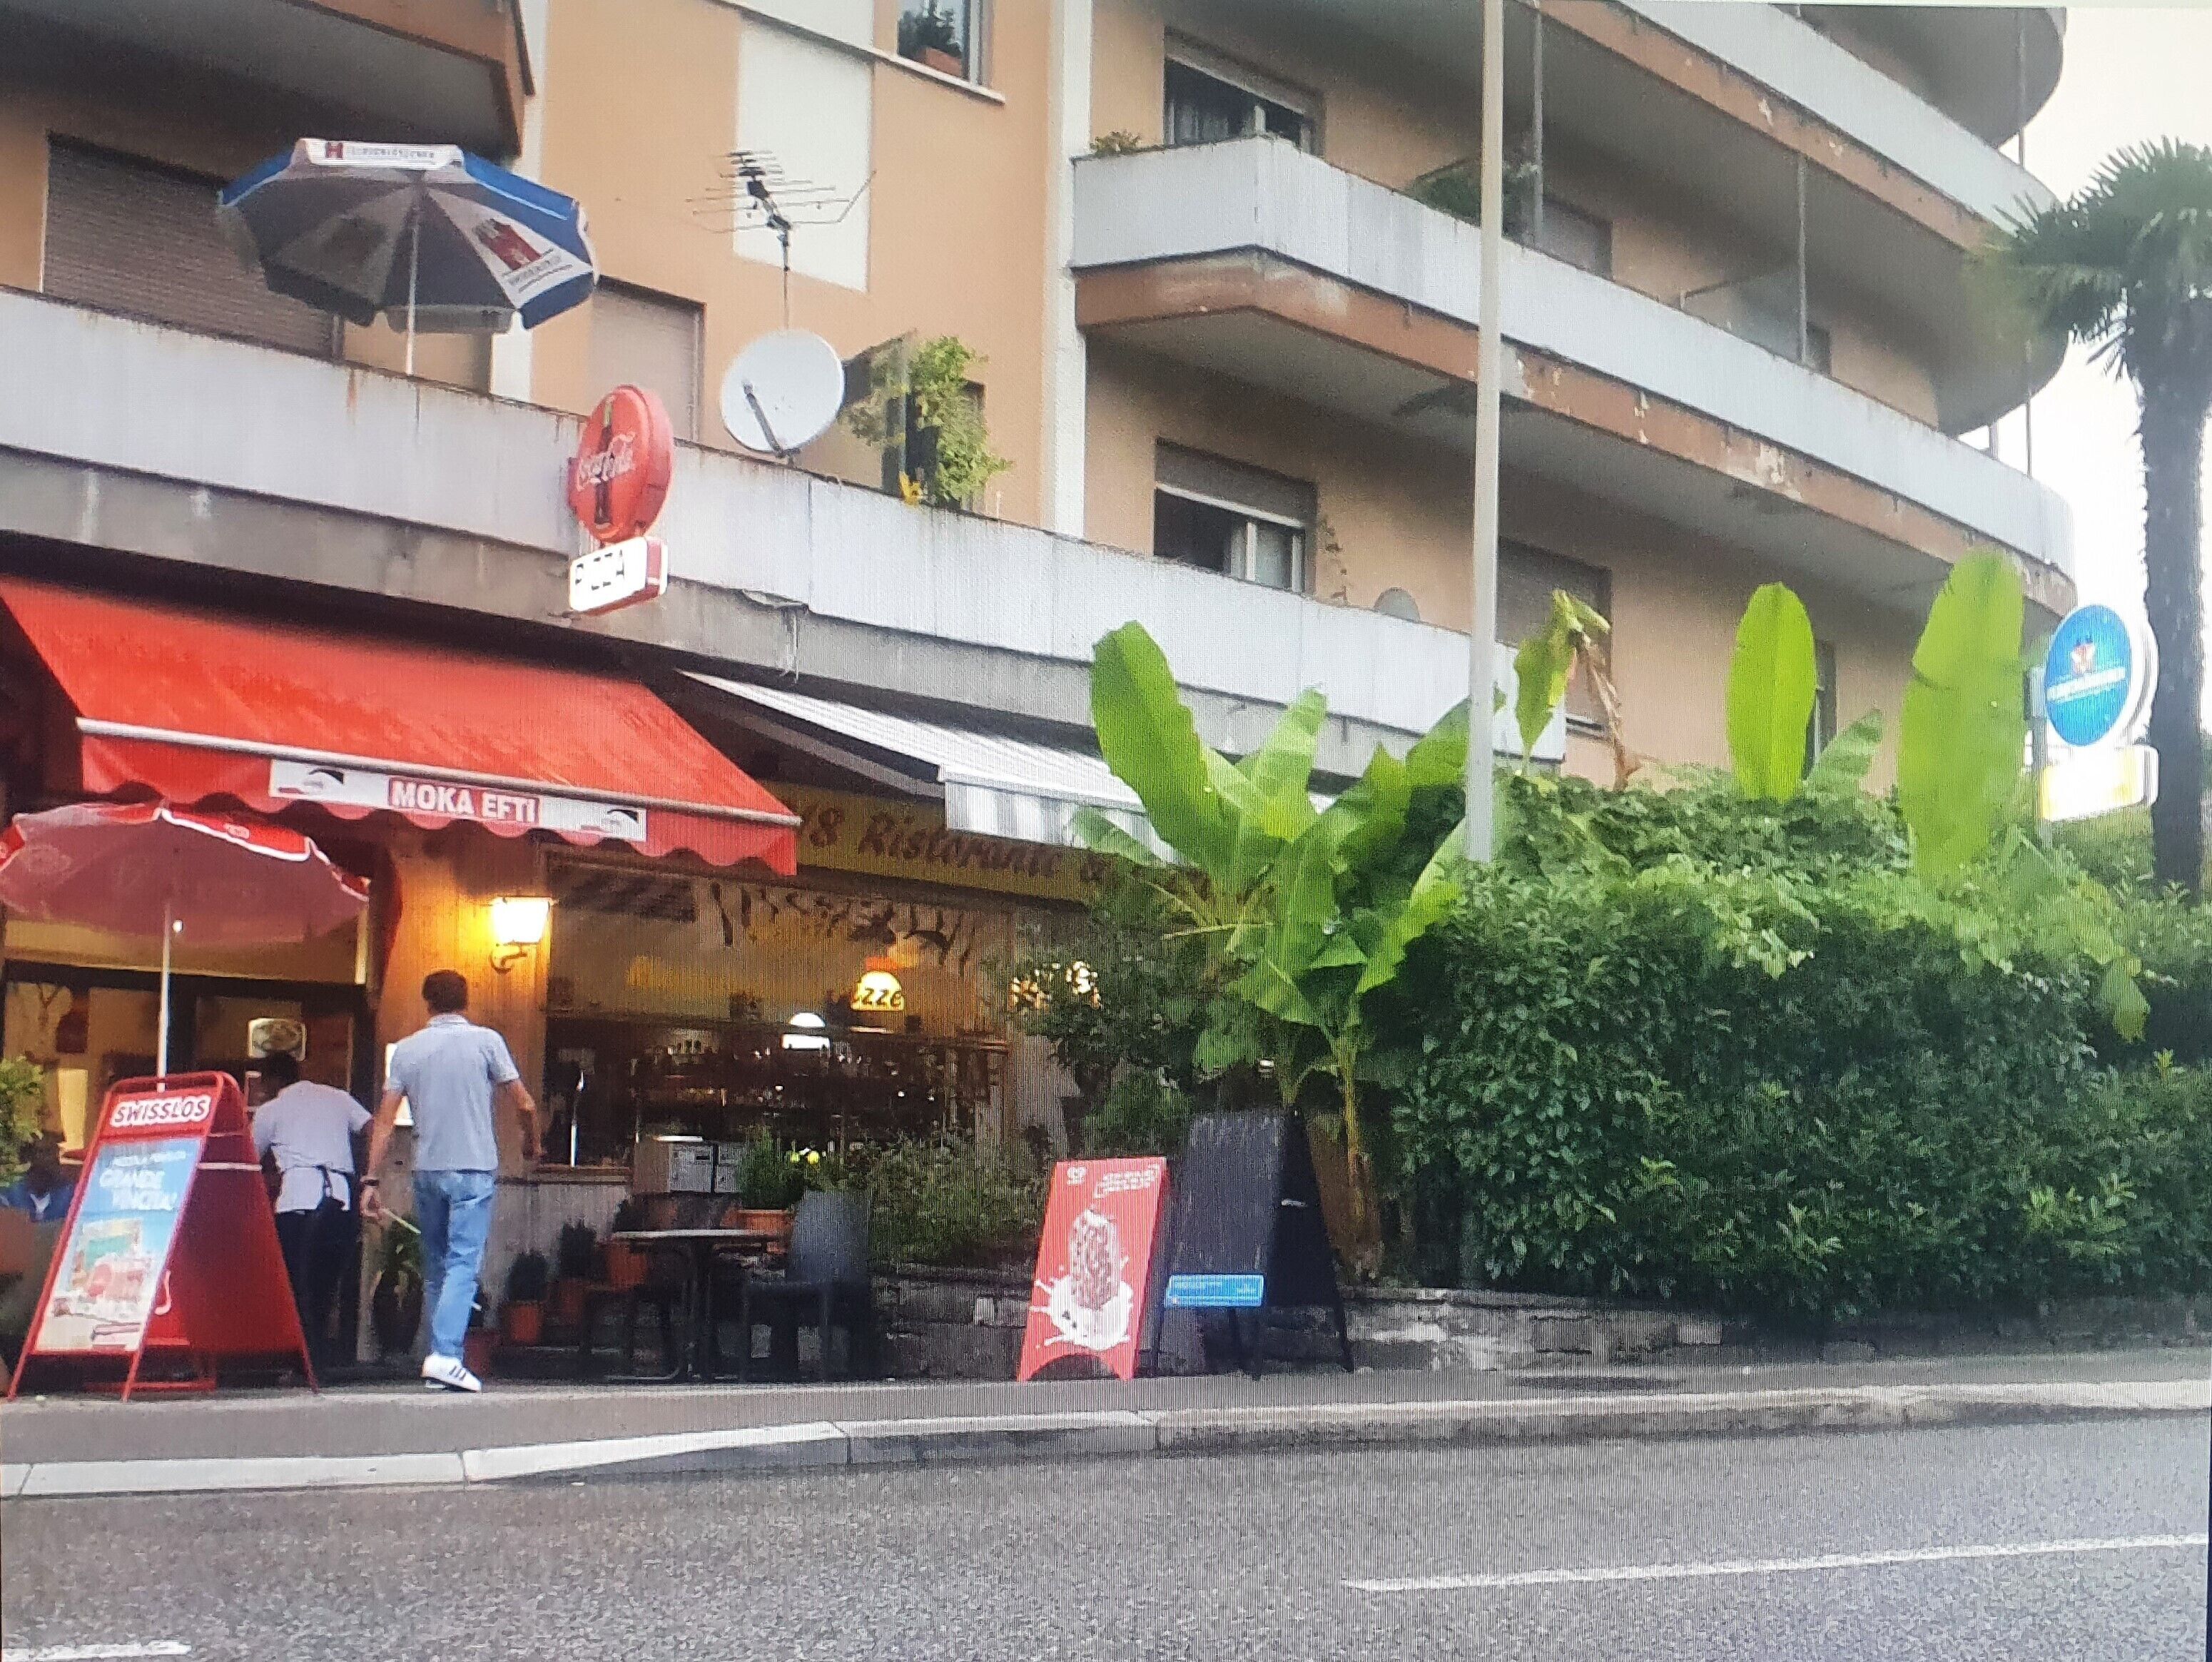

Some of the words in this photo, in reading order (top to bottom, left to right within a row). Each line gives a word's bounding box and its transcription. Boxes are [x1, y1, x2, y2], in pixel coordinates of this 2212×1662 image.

[574, 548, 625, 591] PZZA
[391, 781, 474, 816] MOKA
[482, 794, 535, 824] EFTI
[114, 1099, 206, 1123] SWISSLOS
